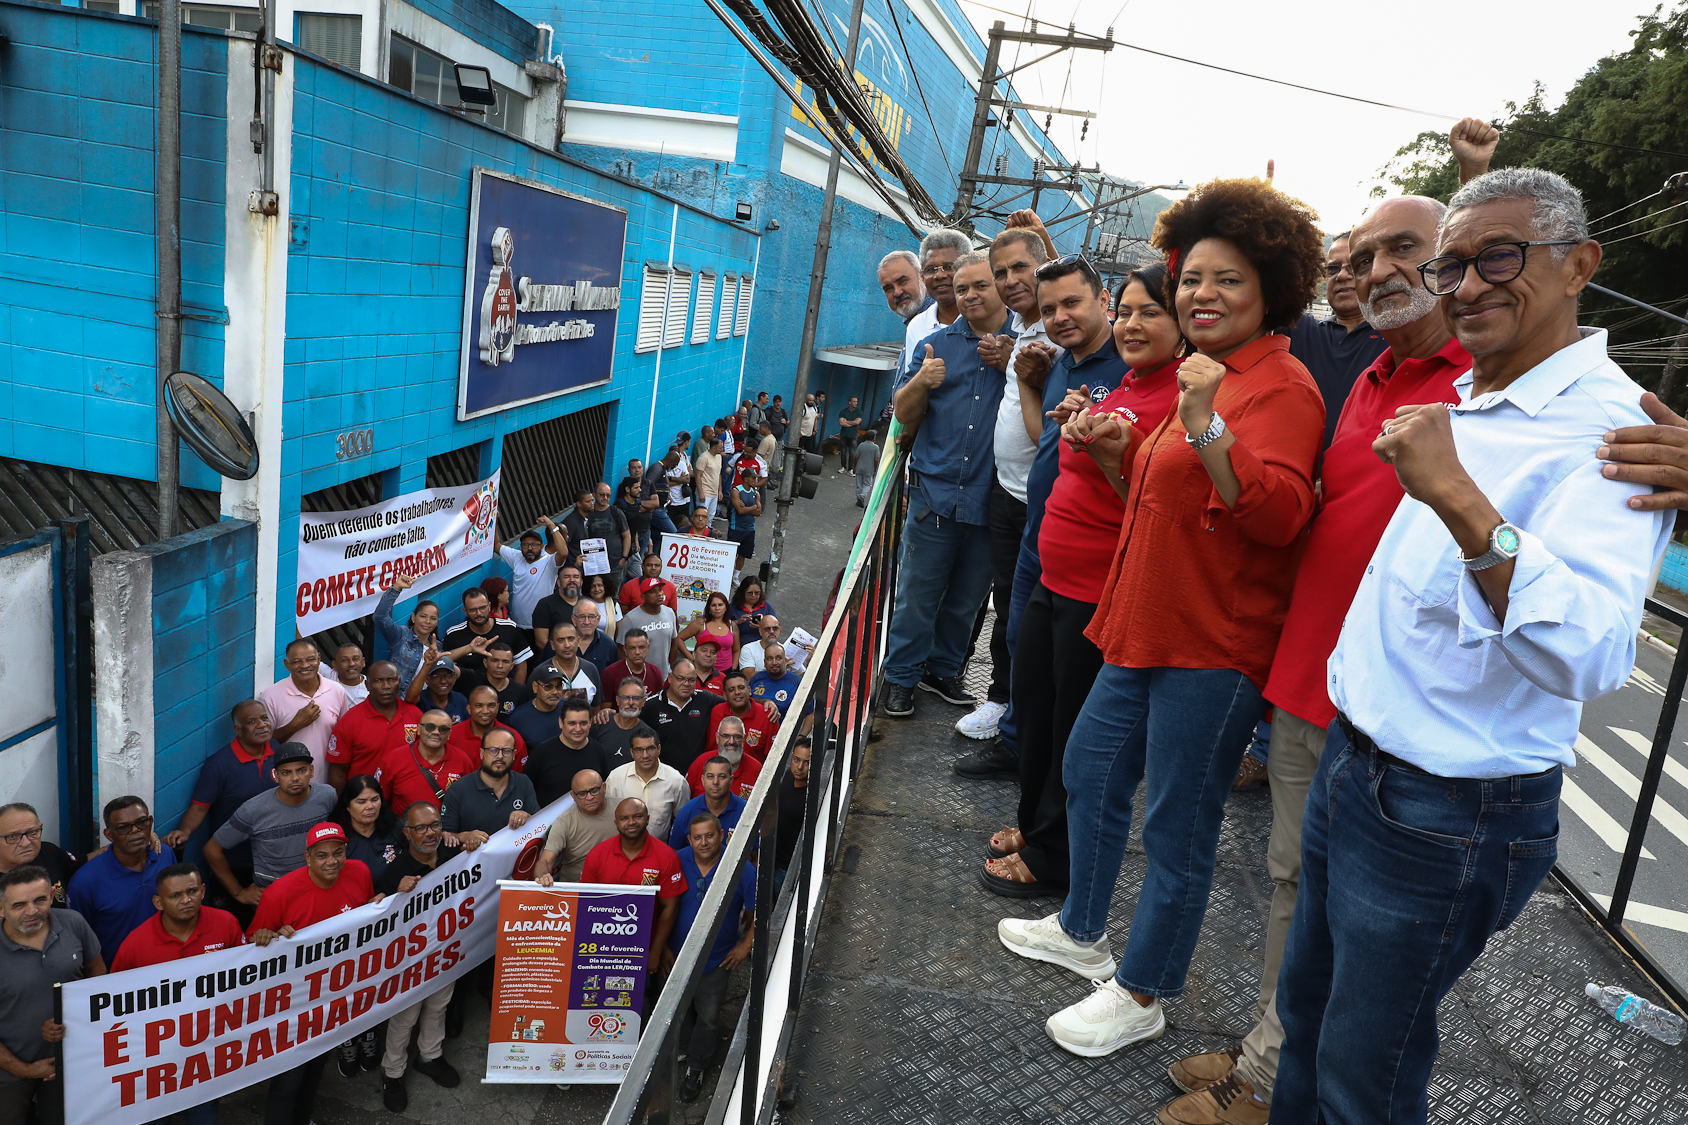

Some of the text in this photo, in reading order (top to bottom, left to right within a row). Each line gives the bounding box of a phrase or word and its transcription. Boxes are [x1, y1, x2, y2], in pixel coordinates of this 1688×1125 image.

[498, 289, 511, 297] COVER
[497, 304, 510, 312] EARTH
[336, 428, 373, 459] 3000
[303, 522, 338, 544] Quem
[338, 512, 383, 536] defende
[385, 510, 399, 526] os
[344, 540, 366, 559] não
[367, 530, 406, 554] comete
[666, 543, 690, 569] 28
[700, 547, 729, 557] Fevereiro
[697, 560, 718, 568] Combate
[296, 565, 377, 617] COMETE
[641, 621, 670, 632] adidas
[753, 687, 765, 696] 20
[514, 823, 547, 848] RUMO AOS
[518, 903, 555, 911] Fevereiro
[587, 905, 623, 914] Fevereiro
[503, 920, 572, 933] LARANJA
[591, 922, 638, 935] ROXO
[90, 863, 483, 1022] Punir quem luta por direitos
[578, 943, 598, 953] 28
[611, 945, 644, 953] fevereiro
[103, 896, 476, 1067] É PUNIR TODOS OS
[112, 940, 466, 1107] TRABALHADORES.
